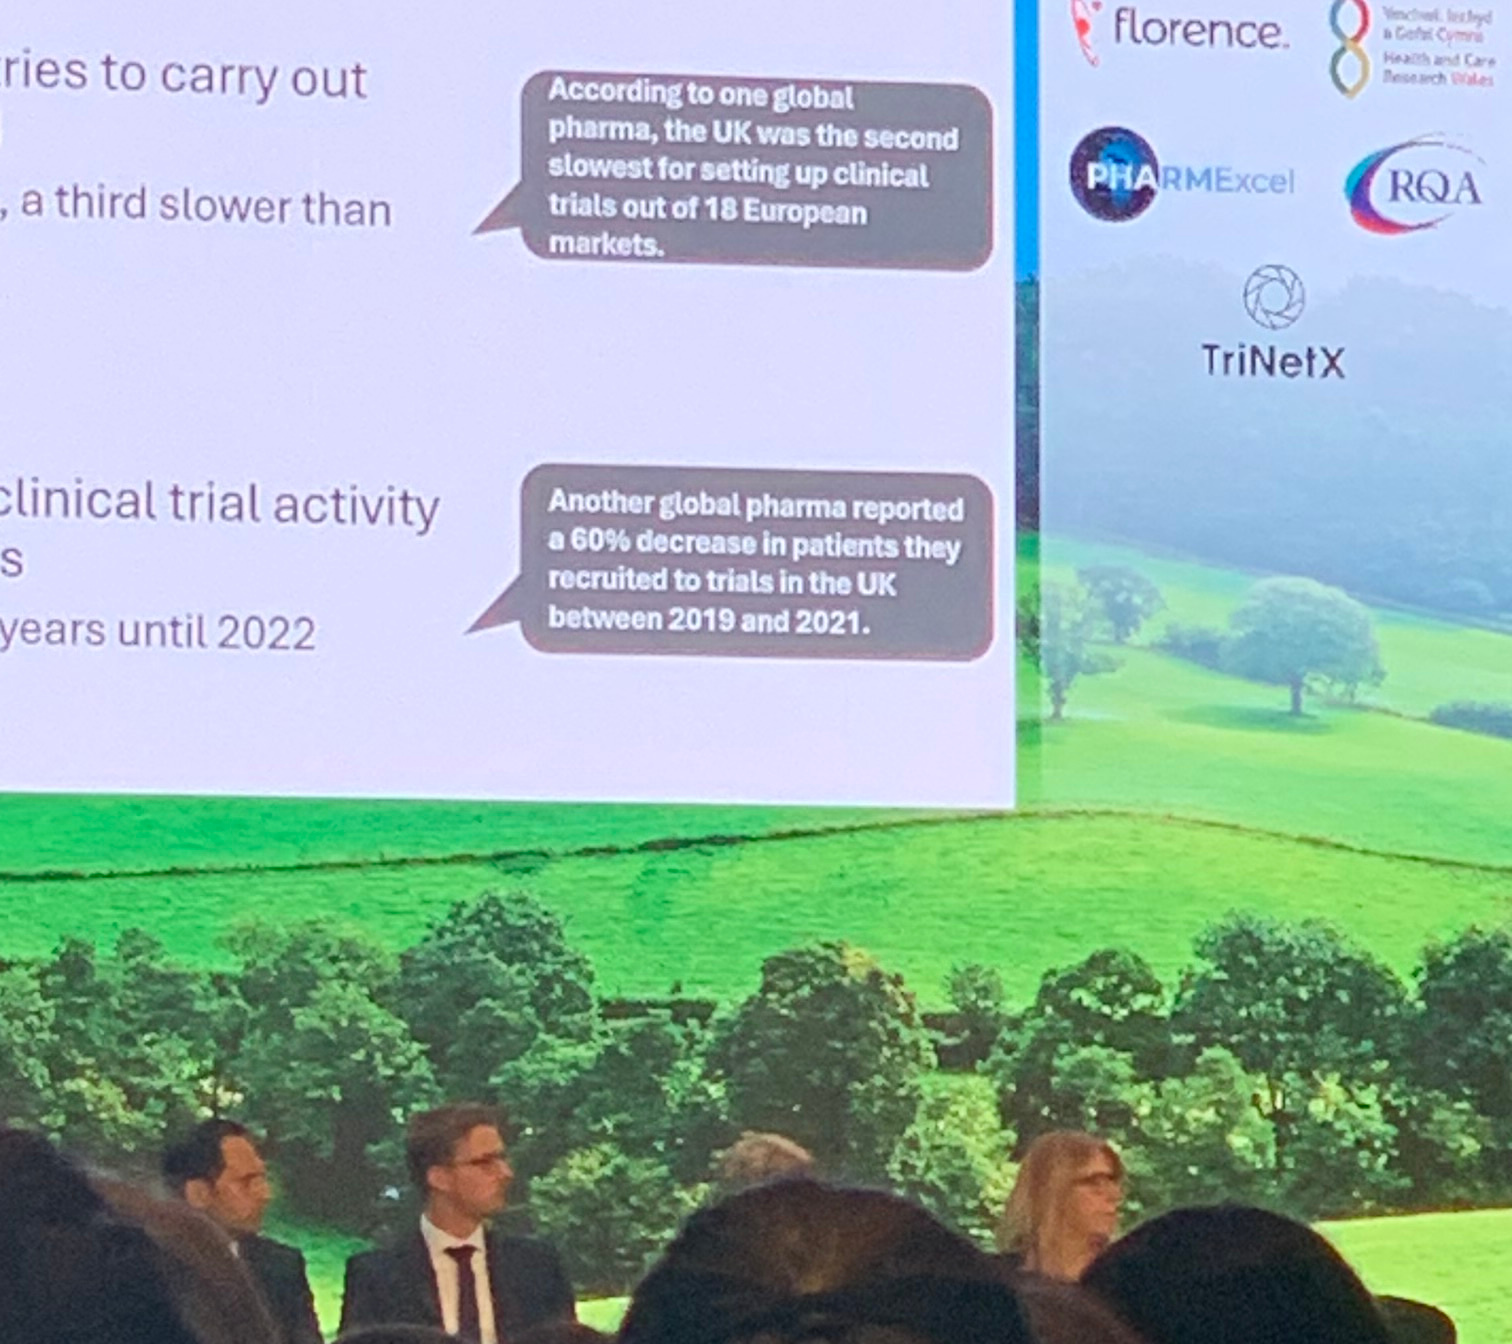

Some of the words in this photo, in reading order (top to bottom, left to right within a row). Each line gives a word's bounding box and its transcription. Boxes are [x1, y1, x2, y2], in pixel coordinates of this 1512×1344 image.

[101, 55, 146, 90] to
[162, 63, 278, 105] carry
[292, 64, 366, 98] out
[549, 77, 683, 109] According
[687, 82, 714, 104] to
[719, 87, 768, 106] one
[773, 85, 853, 113] global
[549, 116, 658, 144] pharma,
[664, 119, 707, 142] the
[713, 120, 751, 144] UK
[757, 126, 810, 146] was
[816, 124, 858, 147] the
[864, 128, 958, 150] second
[549, 154, 653, 179] slowest
[658, 156, 696, 180] for
[701, 158, 790, 188] setting
[796, 166, 828, 188] up
[833, 161, 929, 187] clinical
[1087, 163, 1294, 194] PHARMExcel
[1390, 170, 1480, 204] RQA
[22, 190, 42, 216] a
[55, 184, 145, 219] third
[160, 187, 291, 223] slower
[302, 192, 390, 226] than
[549, 192, 617, 217] trials
[623, 197, 666, 218] out
[672, 196, 699, 219] of
[705, 197, 738, 220] 18
[743, 198, 867, 228] European
[550, 232, 664, 256] markets.
[1202, 343, 1344, 378] TriNetX
[169, 481, 260, 522] trial
[274, 485, 440, 536] activity
[548, 488, 655, 513] Another
[659, 491, 740, 520] global
[746, 494, 846, 522] pharma
[853, 498, 963, 525] reported
[548, 532, 564, 550] a
[571, 527, 631, 551] 60%
[636, 529, 757, 555] decrease
[763, 530, 786, 555] in
[793, 532, 899, 561] patients
[905, 535, 961, 565] they
[549, 566, 667, 590] recruited
[674, 570, 701, 591] to
[706, 570, 774, 593] trials
[780, 570, 803, 593] in
[809, 571, 852, 594] the
[857, 572, 896, 596] UK
[119, 614, 206, 648] until
[218, 615, 314, 650] 2022
[549, 605, 662, 629] between
[668, 607, 735, 631] 2019
[741, 610, 789, 632] and
[796, 610, 870, 634] 2021.
